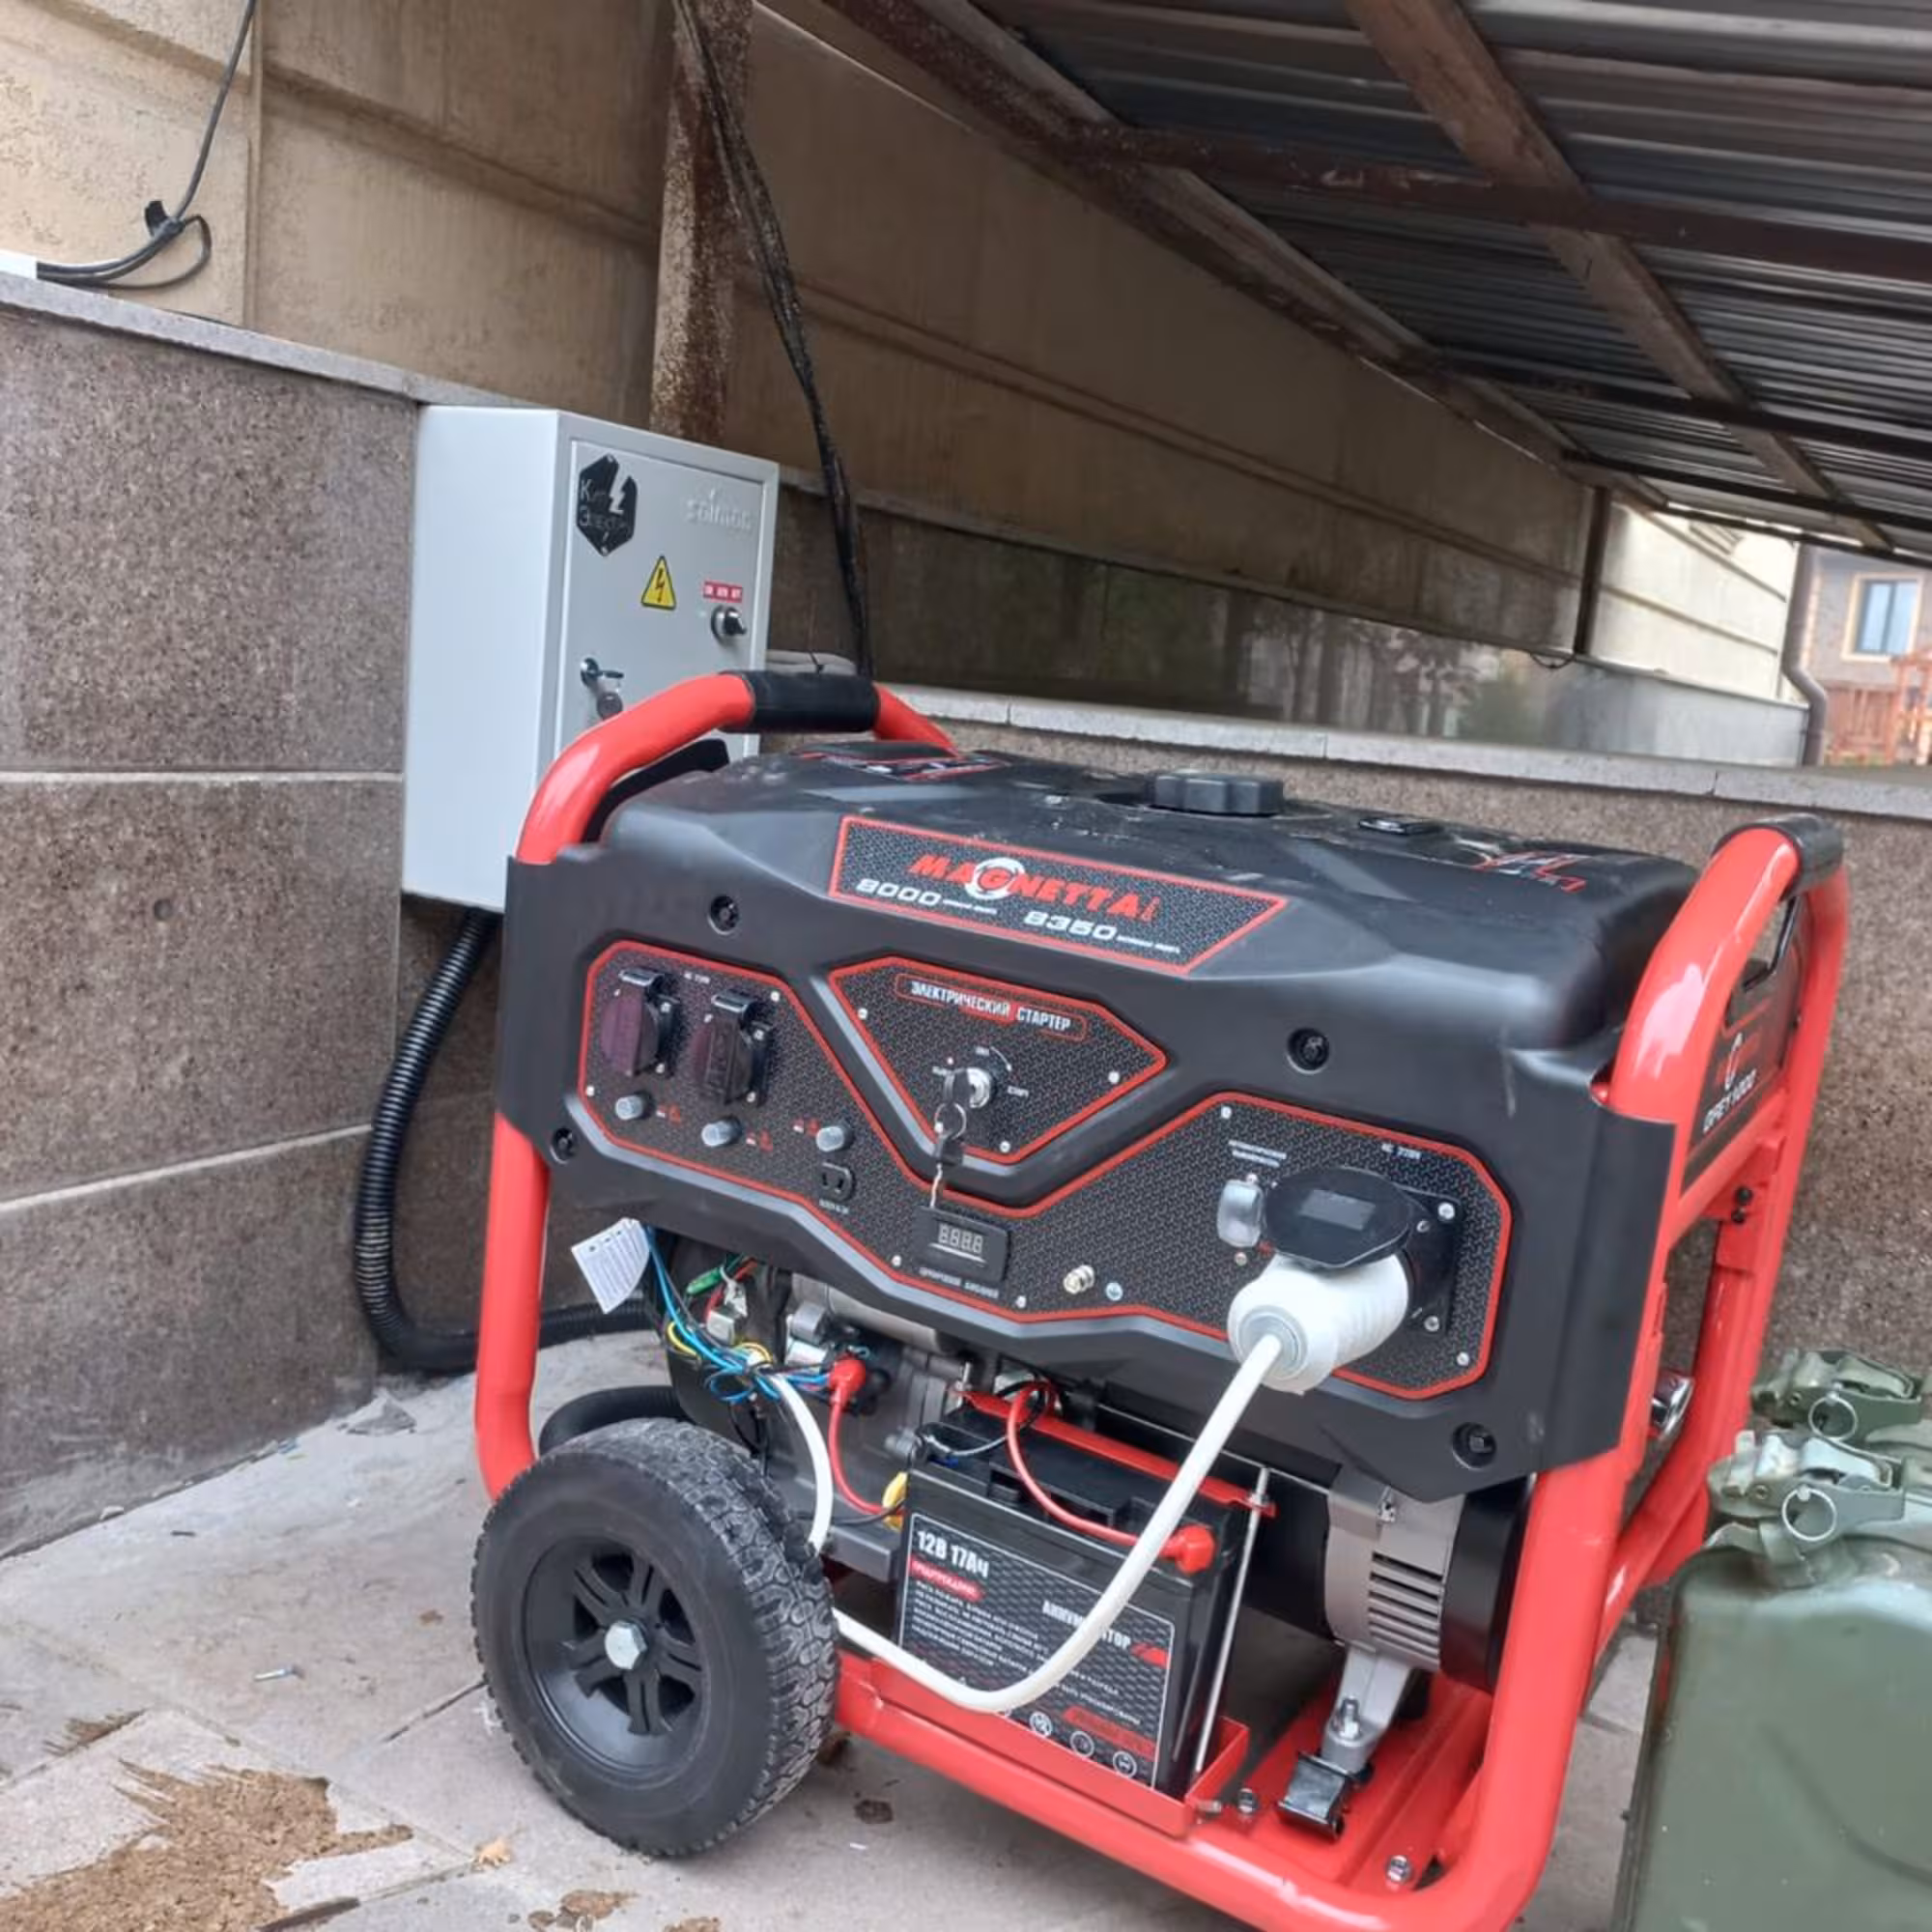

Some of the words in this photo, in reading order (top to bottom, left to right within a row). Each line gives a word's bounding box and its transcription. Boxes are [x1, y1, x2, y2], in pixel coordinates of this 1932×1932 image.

[908, 855, 1140, 921] MAGNETTA
[1024, 911, 1118, 941] 8350
[911, 980, 1011, 1020] ЭЛЕКТРИЧЕСКИЙ
[1016, 1006, 1071, 1031] СТАРТЕР
[917, 1530, 948, 1561] 12В
